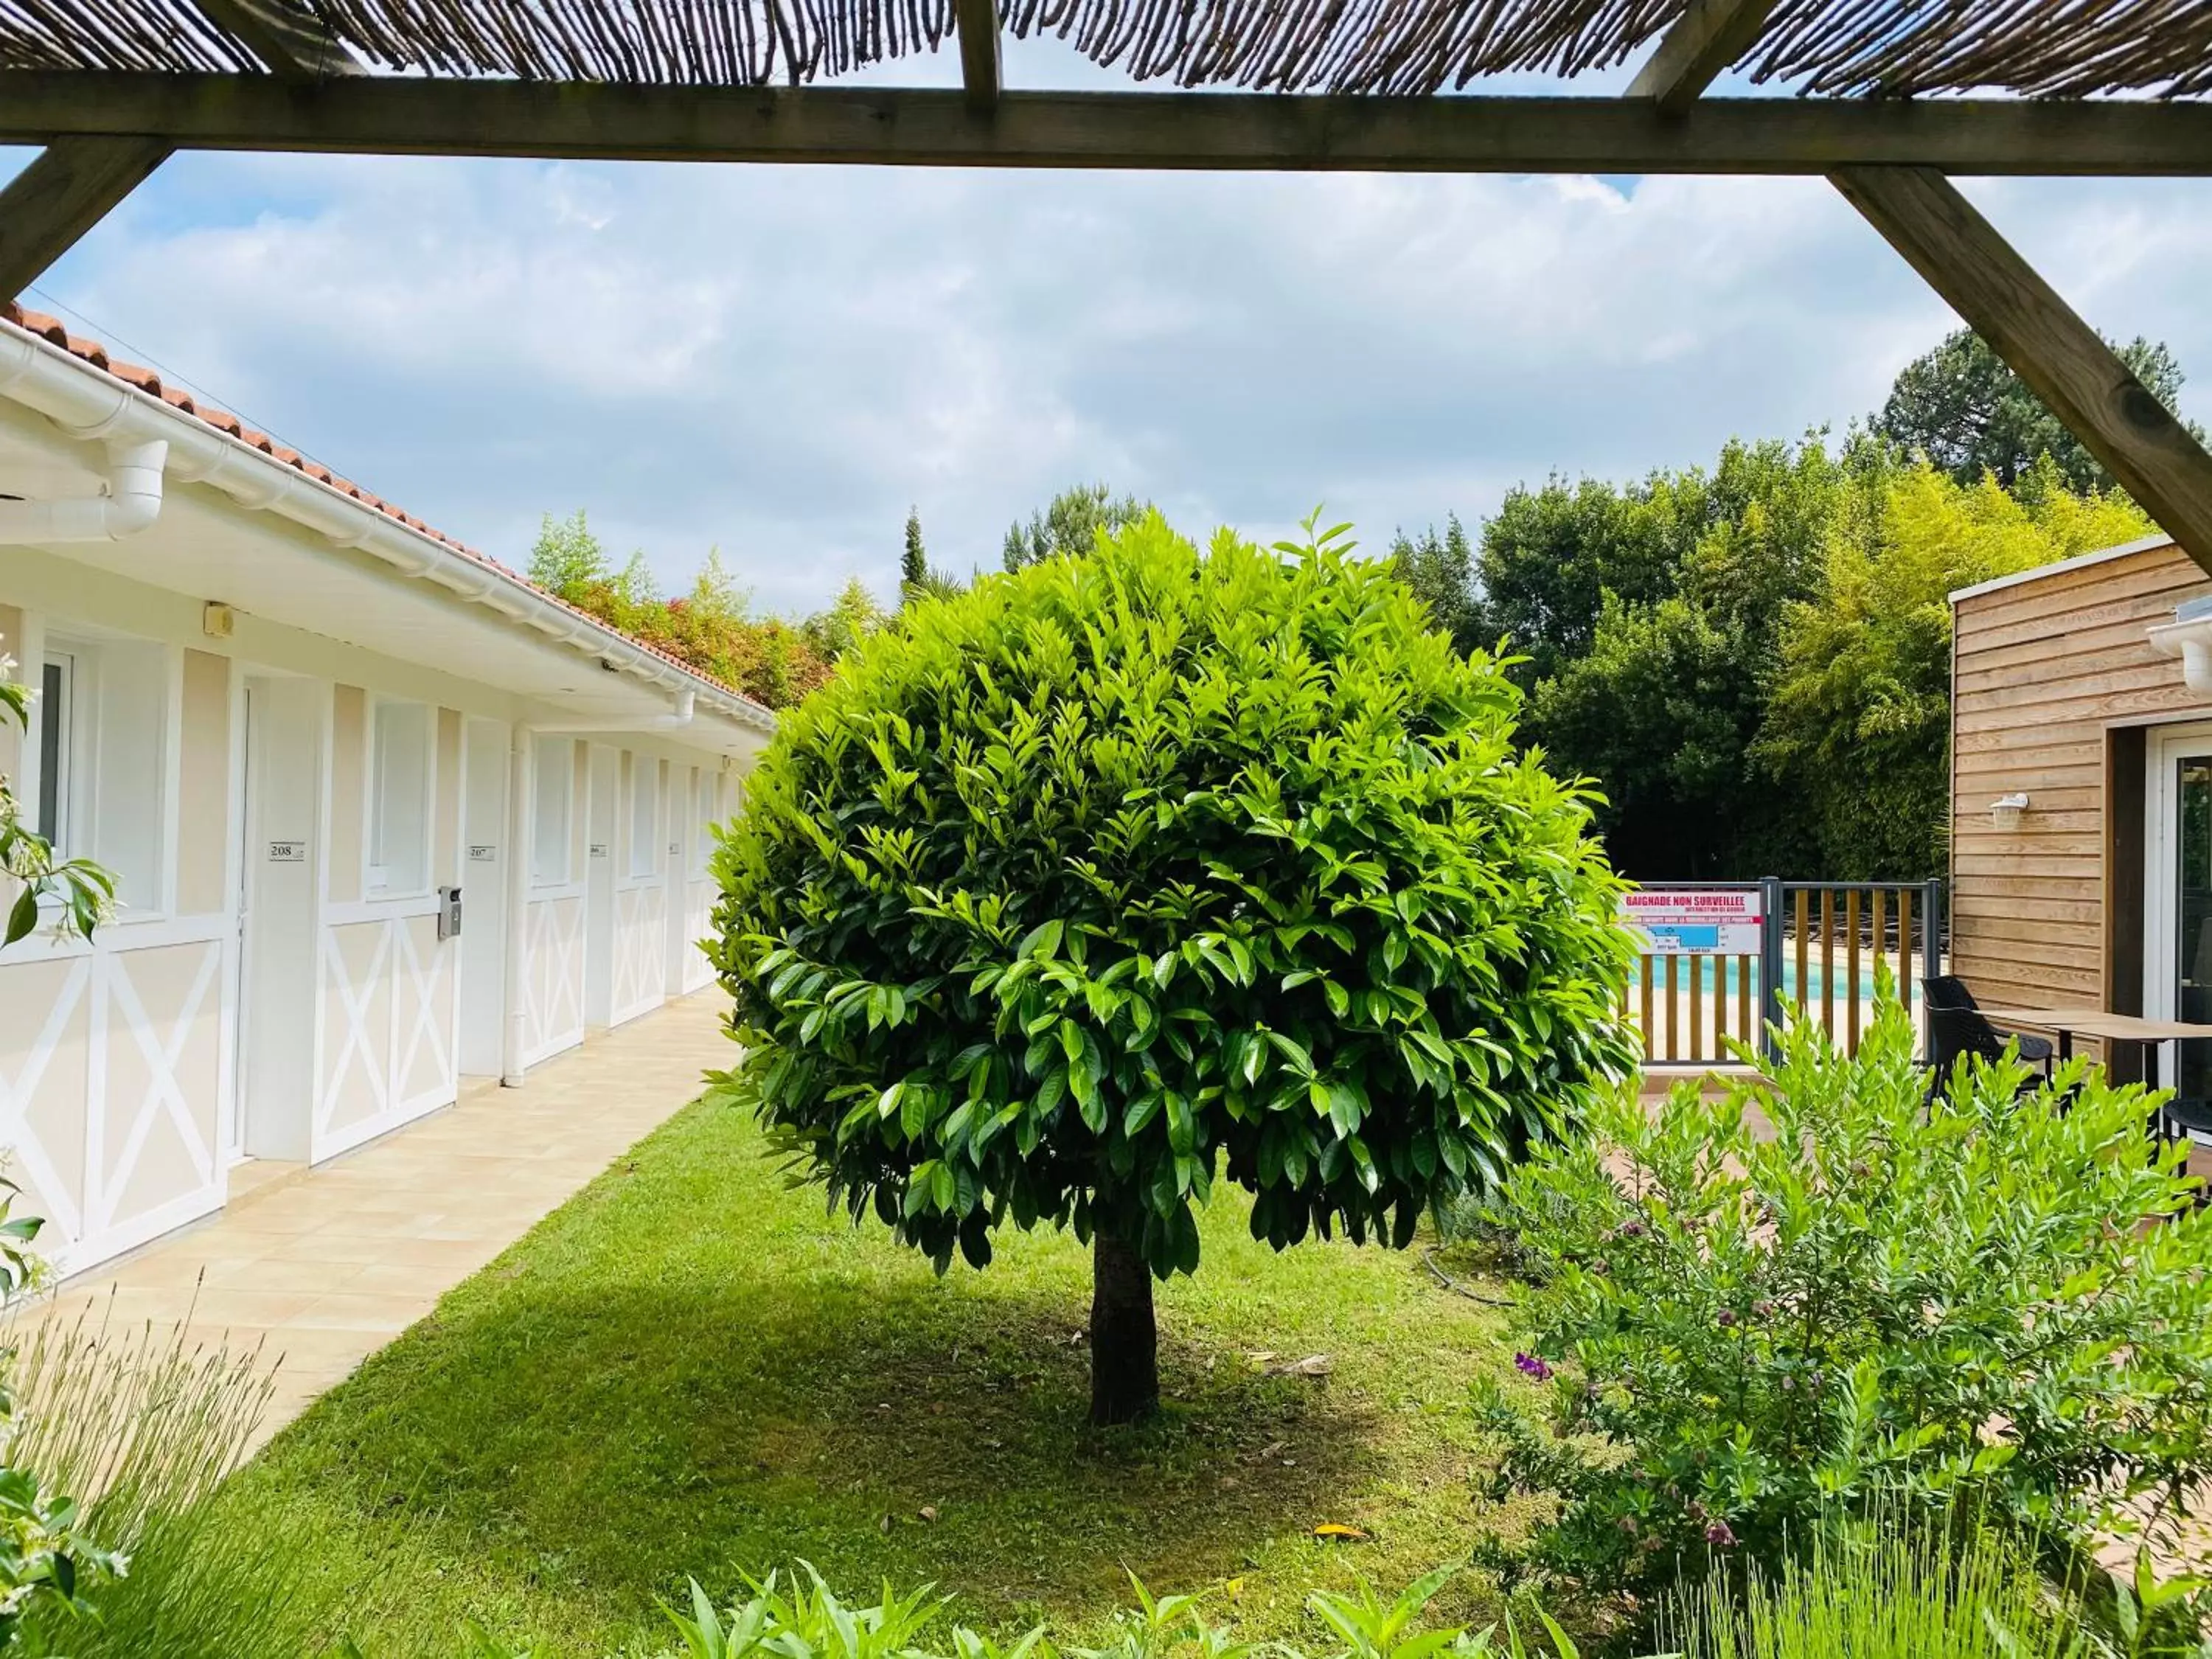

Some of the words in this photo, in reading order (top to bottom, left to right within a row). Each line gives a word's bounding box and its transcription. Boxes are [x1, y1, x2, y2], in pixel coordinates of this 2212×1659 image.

[271, 846, 291, 855] 208
[1626, 896, 1672, 906] BAIGNADE
[1673, 896, 1692, 906] NON
[1694, 896, 1745, 906] SURVEILLEE
